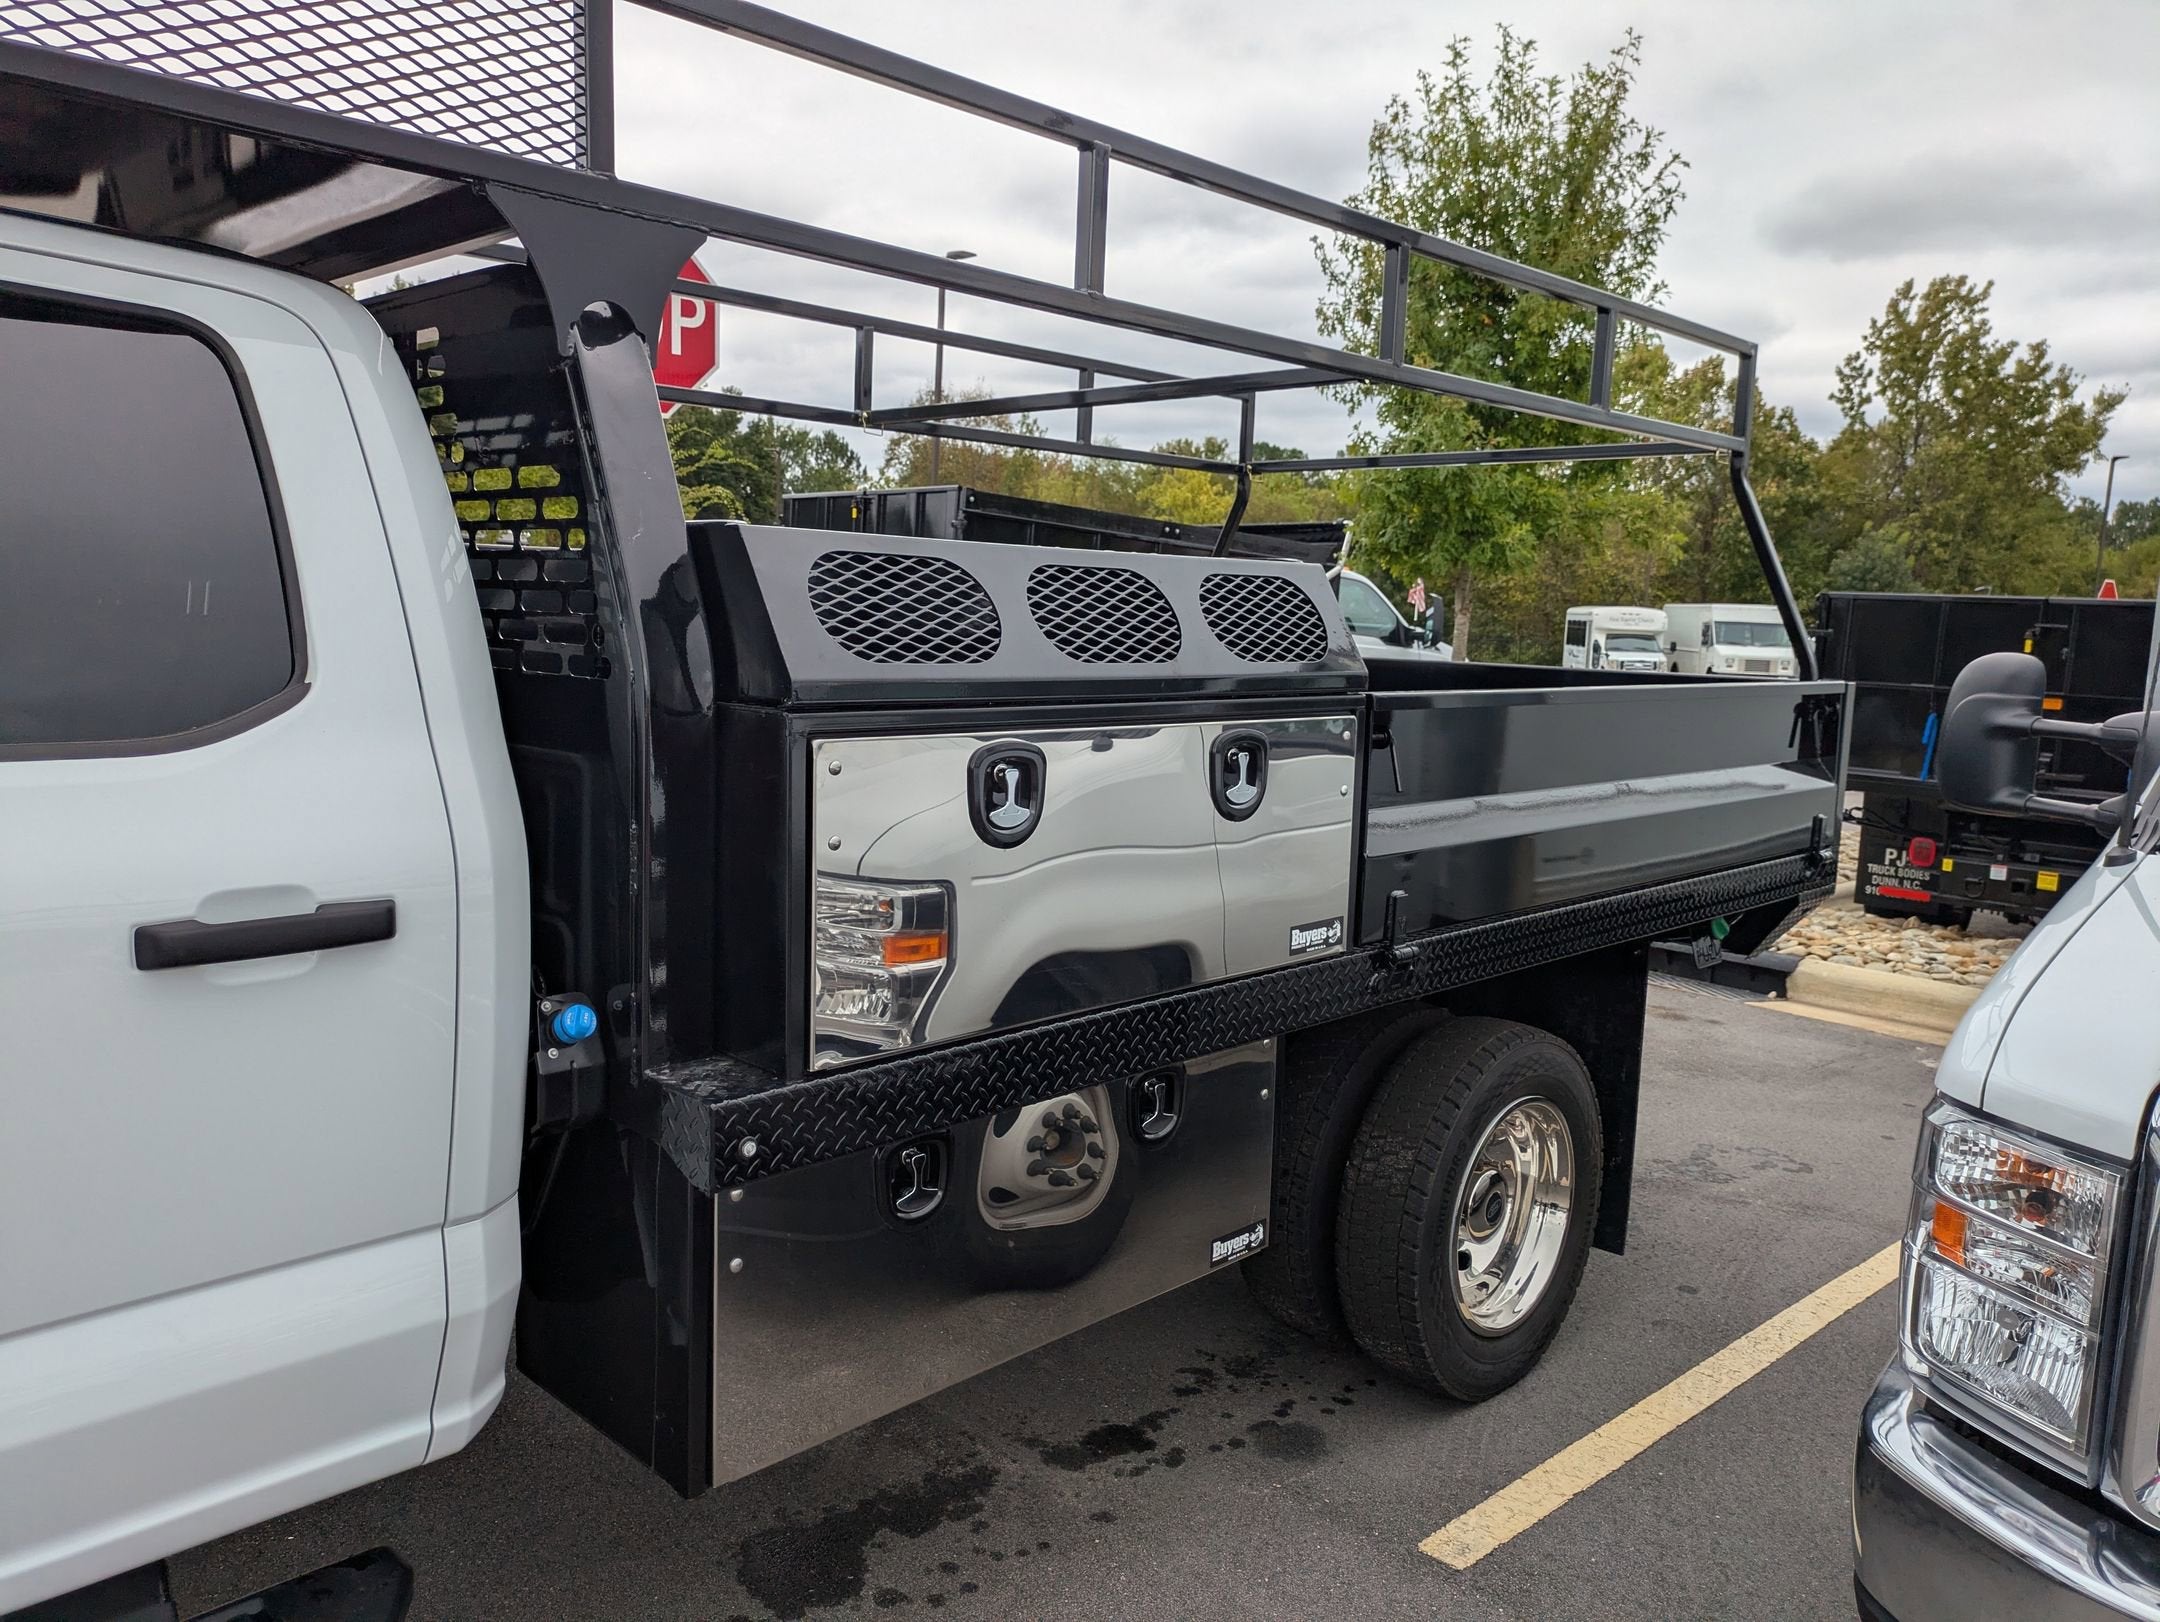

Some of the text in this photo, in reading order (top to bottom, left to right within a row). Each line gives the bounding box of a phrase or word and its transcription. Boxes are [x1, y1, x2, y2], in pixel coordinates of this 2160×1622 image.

[1867, 863, 1931, 881] TRUCK BODIES
[1291, 927, 1328, 947] Buyers
[1212, 1233, 1249, 1256] Buyers
